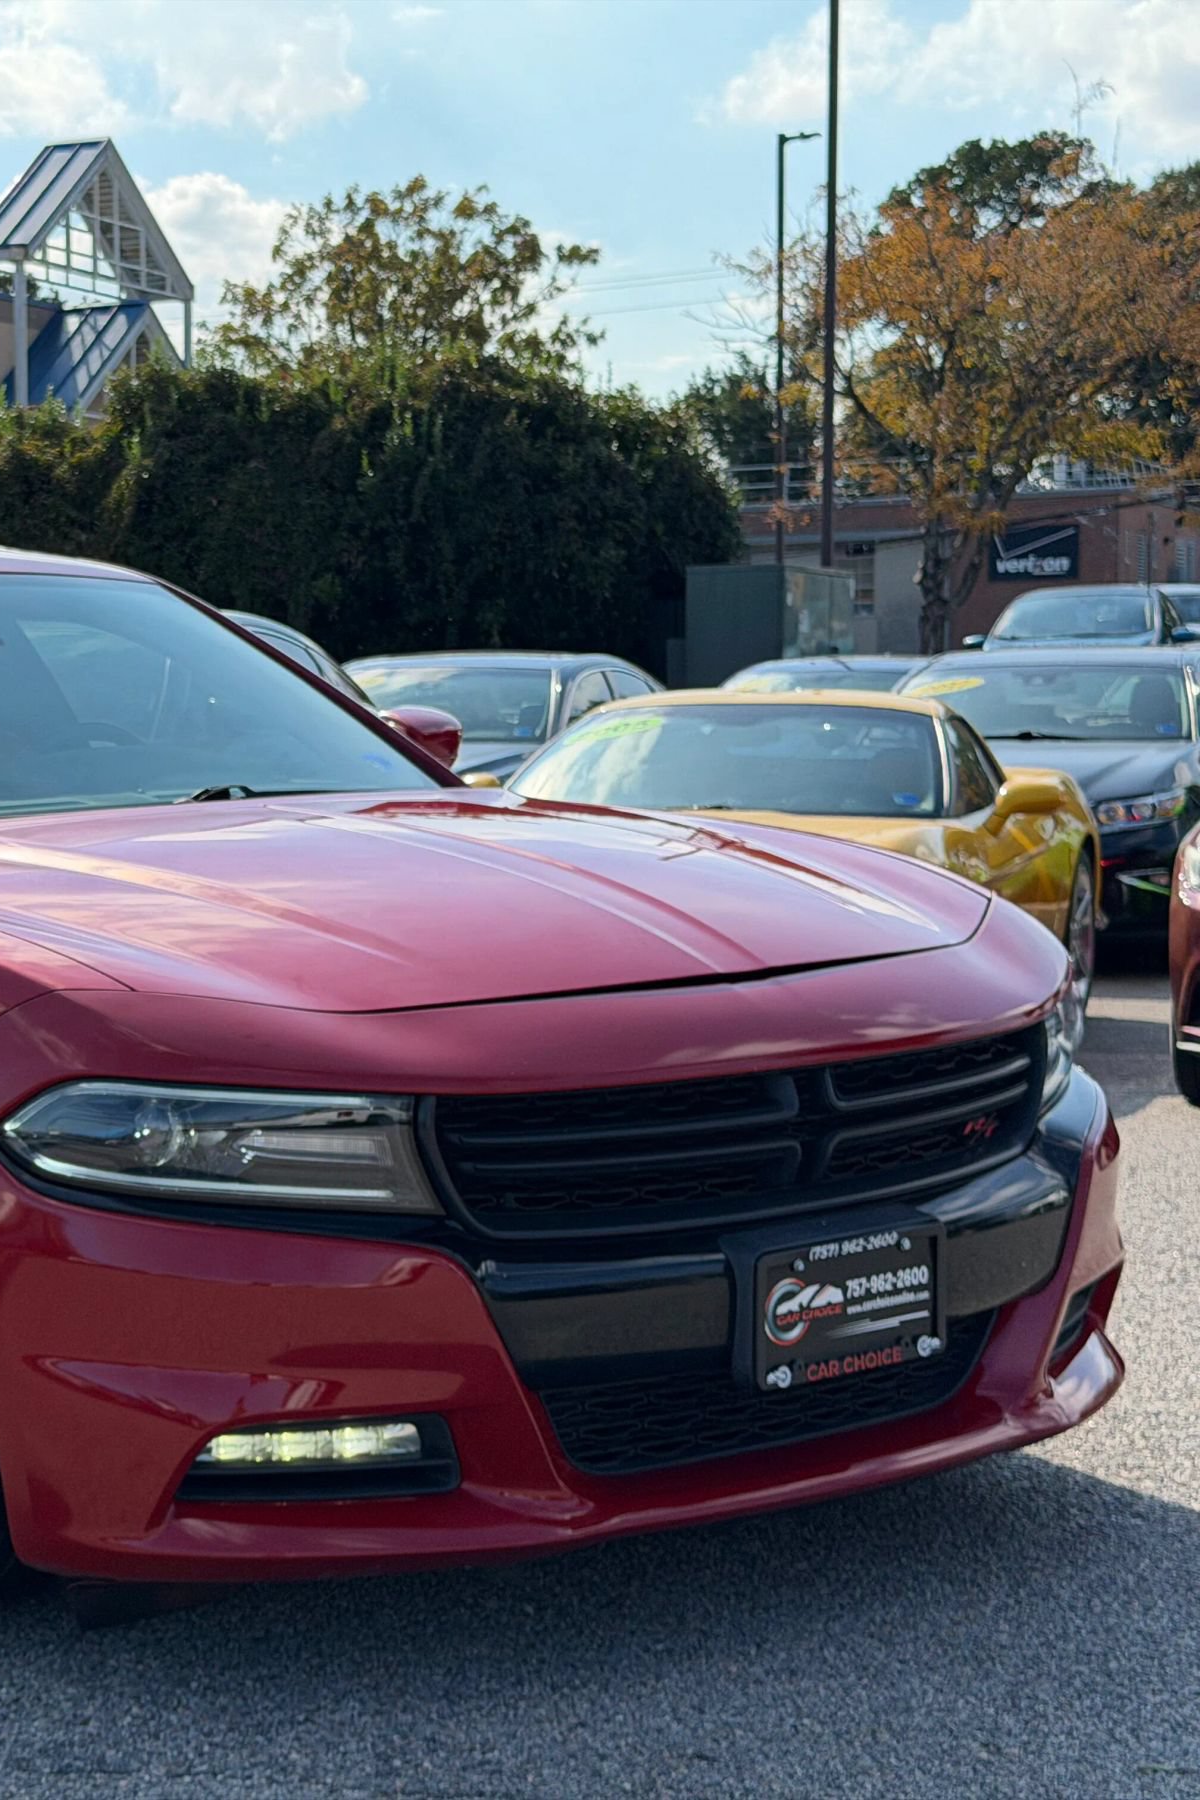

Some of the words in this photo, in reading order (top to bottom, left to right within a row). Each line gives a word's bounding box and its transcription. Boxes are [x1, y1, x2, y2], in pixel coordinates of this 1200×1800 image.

[841, 1230, 898, 1256] 962-2600
[846, 1265, 929, 1299] 757-962-2600
[776, 1312, 801, 1326] CAR
[802, 1303, 842, 1321] CHOICE
[807, 1360, 839, 1381] CAR
[843, 1345, 902, 1374] CHOICE
